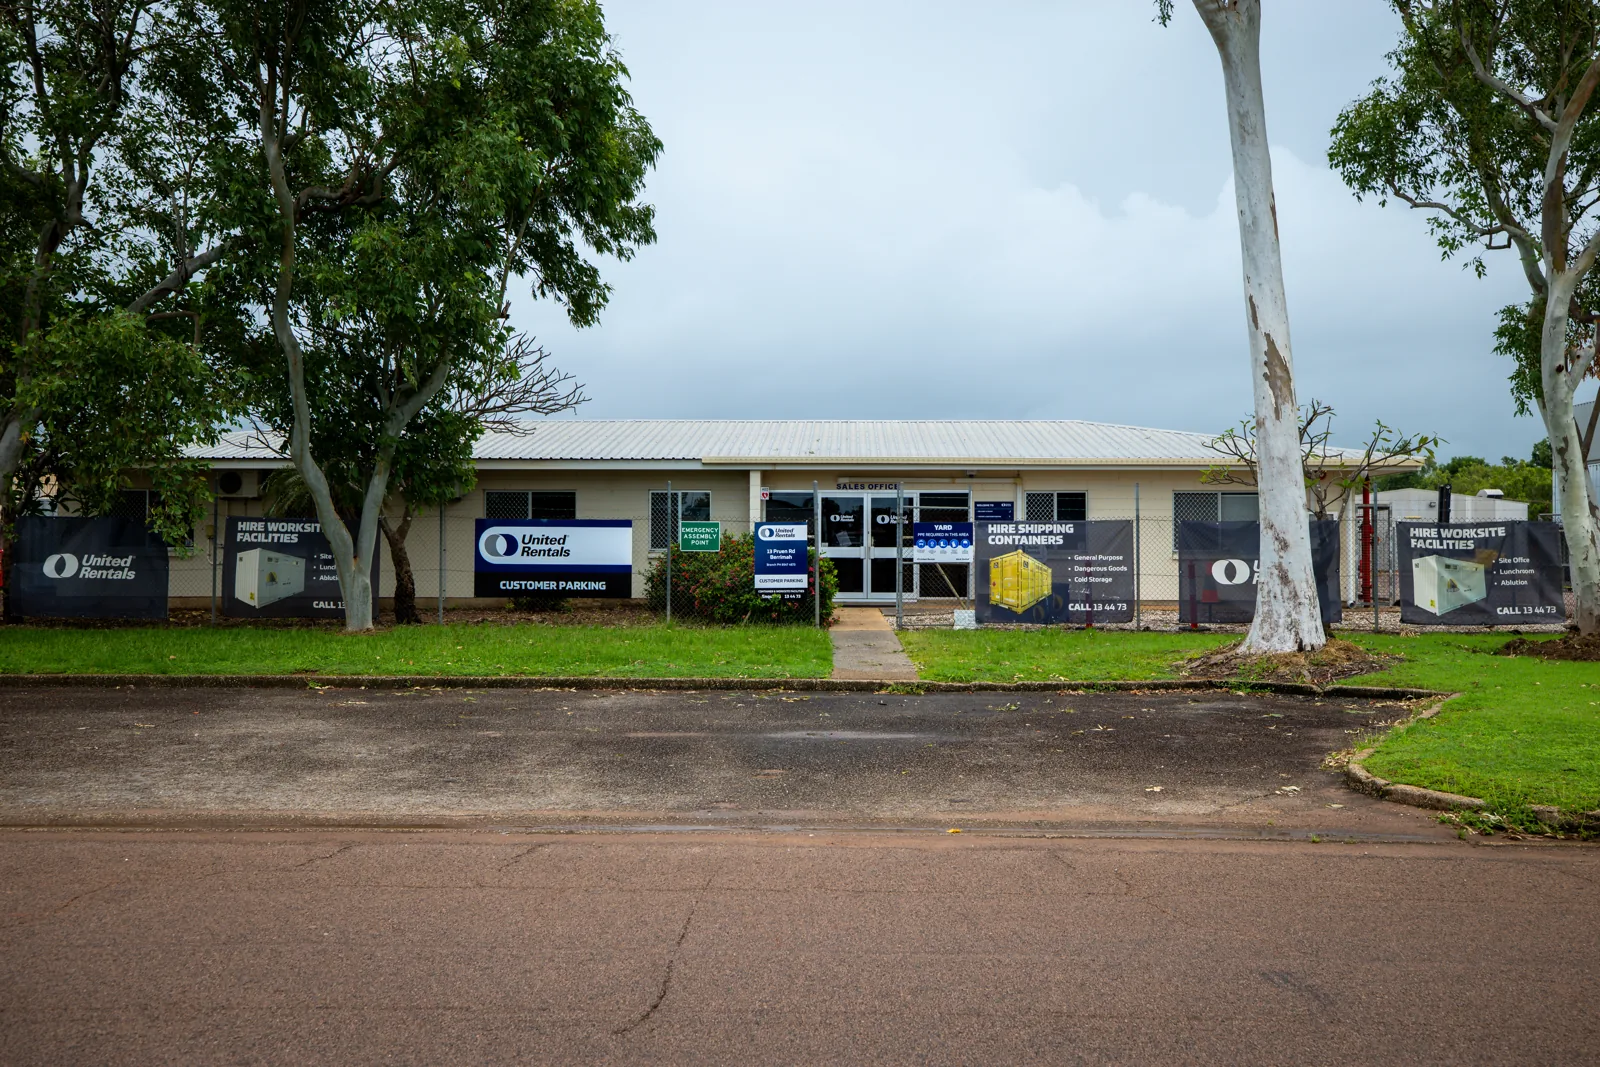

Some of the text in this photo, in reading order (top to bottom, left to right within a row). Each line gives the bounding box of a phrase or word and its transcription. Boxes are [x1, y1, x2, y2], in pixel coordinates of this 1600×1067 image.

[237, 521, 324, 533] HIRE WORKSIT
[988, 524, 1074, 534] HIRE SHIPPING
[1410, 526, 1506, 538] HIRE WORKSITE
[236, 532, 299, 543] FACILITIES
[521, 534, 567, 545] United
[988, 535, 1064, 545] CONTAINERS
[1410, 538, 1475, 550] FACILITIES
[520, 546, 571, 557] Rentals
[82, 554, 133, 567] United
[79, 566, 136, 580] Rentals
[499, 580, 607, 591] CUSTOMER PARKING
[313, 601, 336, 609] CALL
[1068, 603, 1127, 611] CALL 13 44 73
[1496, 605, 1557, 615] CALL 13 44 73
